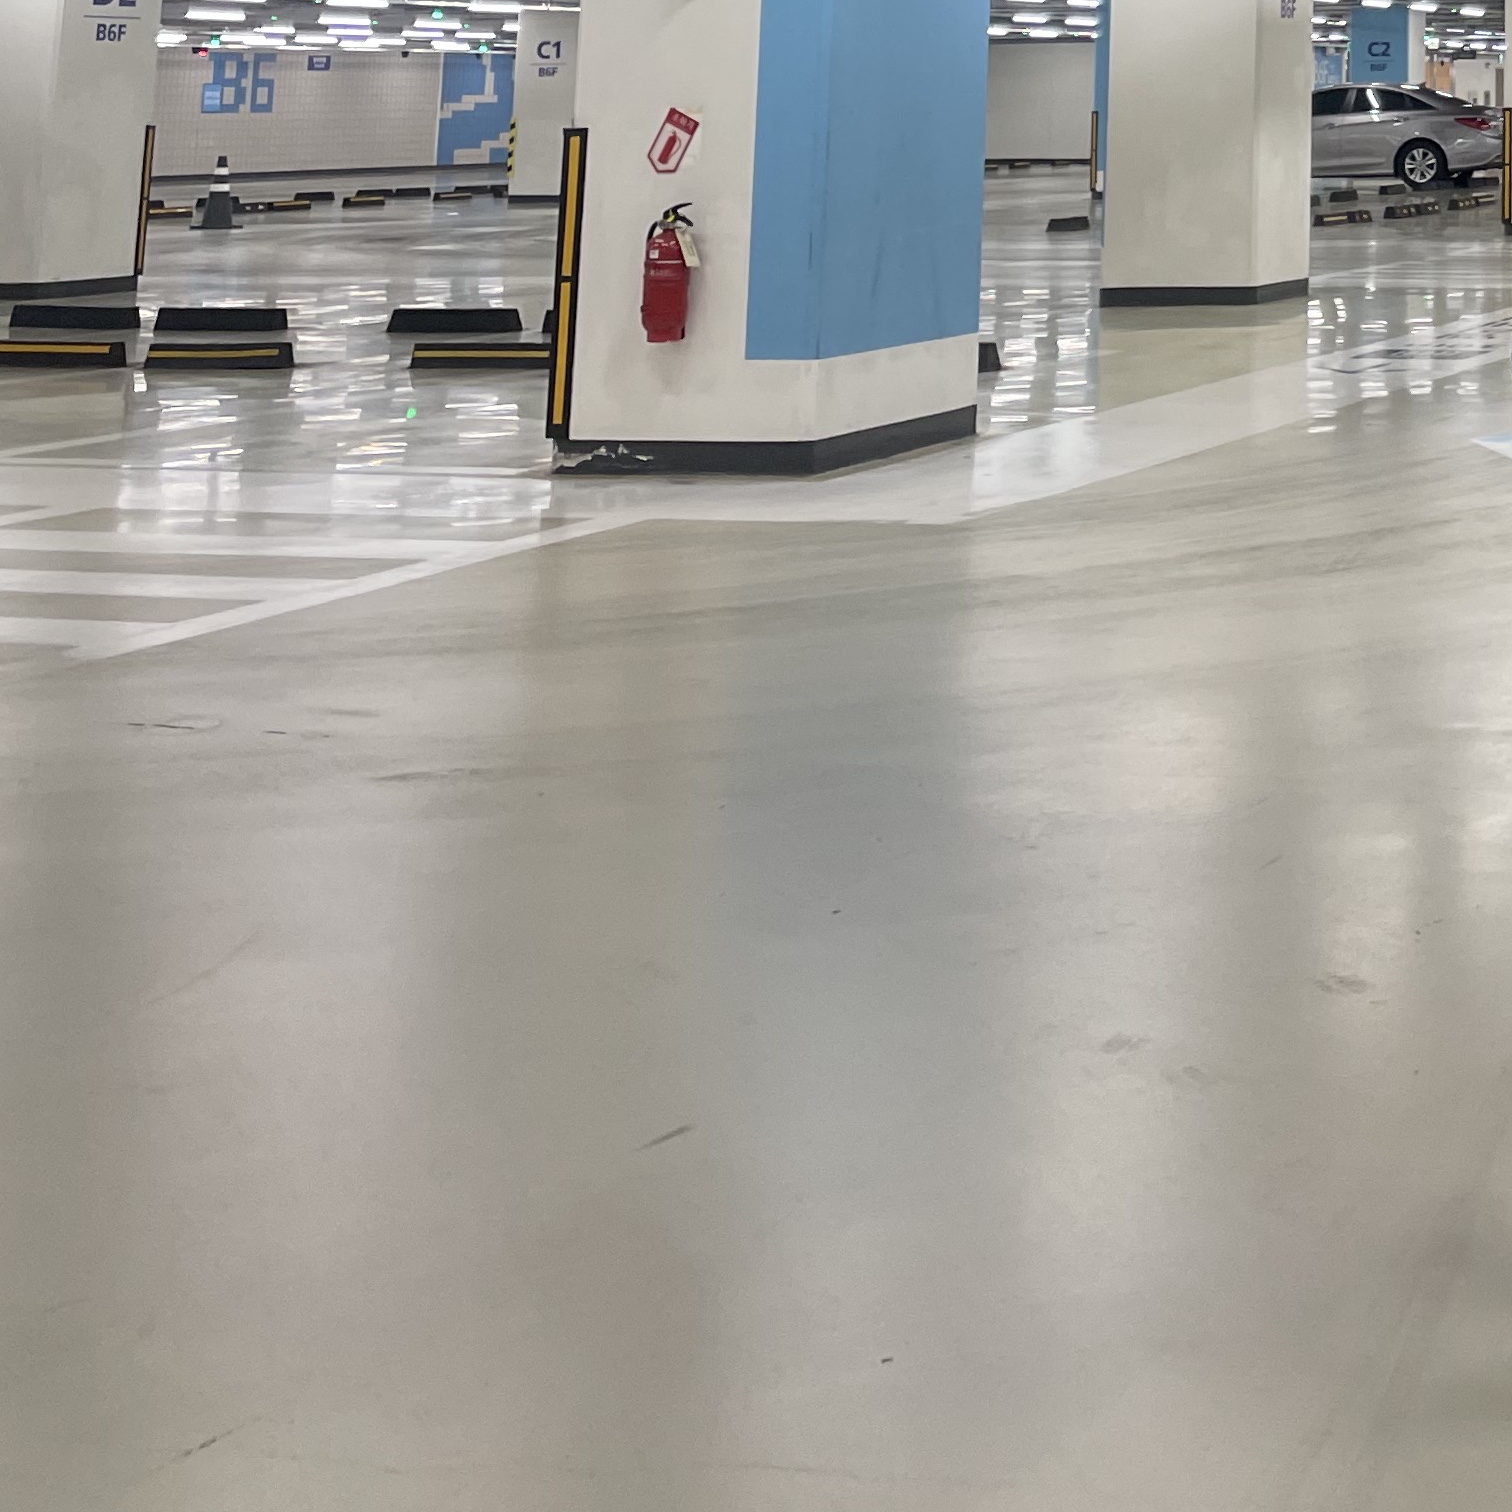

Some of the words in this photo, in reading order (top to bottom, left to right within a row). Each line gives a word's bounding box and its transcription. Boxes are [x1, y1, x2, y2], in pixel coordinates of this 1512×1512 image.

[95, 23, 127, 42] B6F
[537, 40, 561, 59] C1
[1367, 41, 1391, 57] C2
[209, 52, 277, 113] B6
